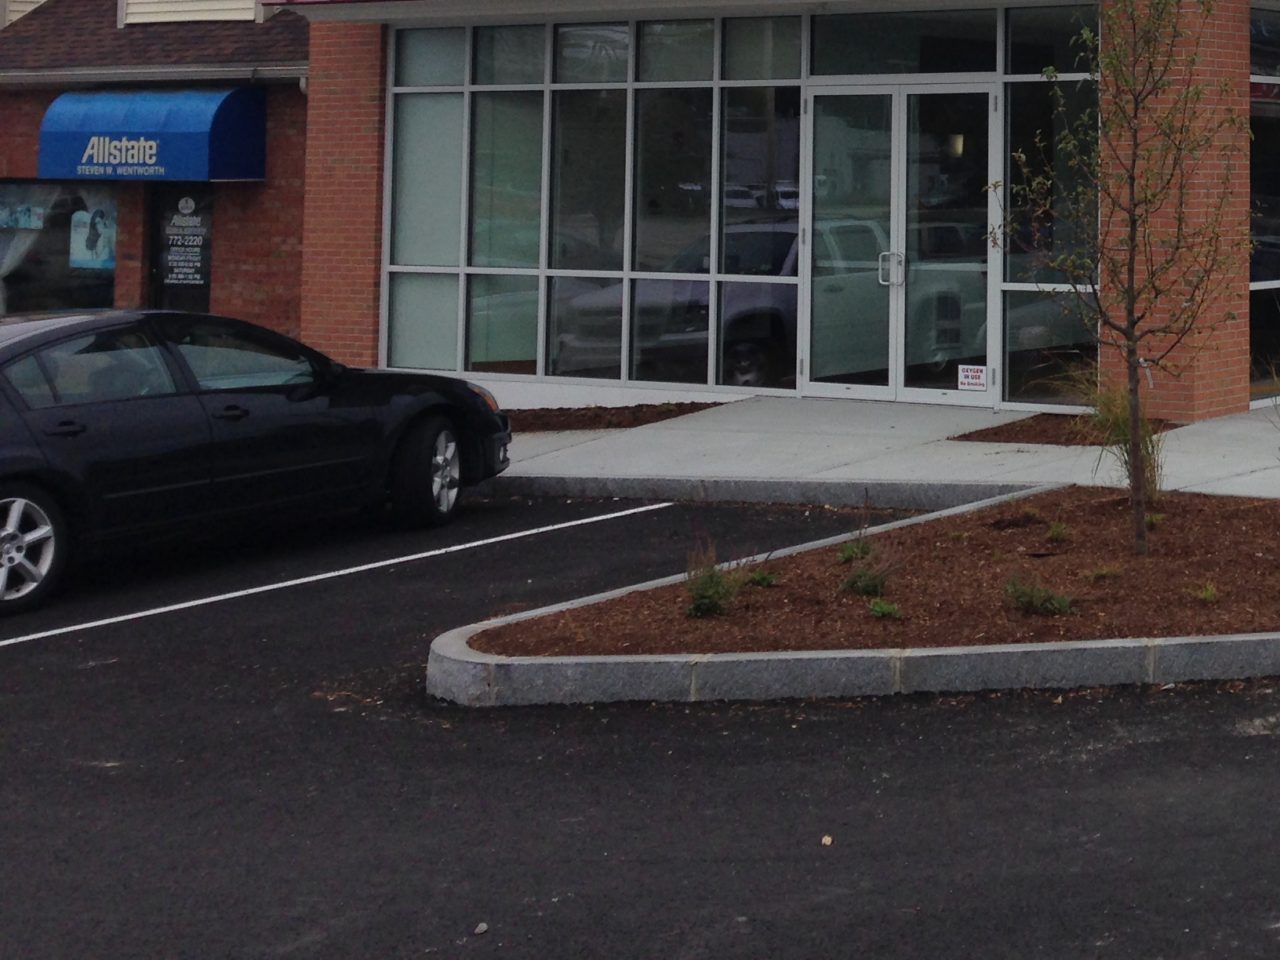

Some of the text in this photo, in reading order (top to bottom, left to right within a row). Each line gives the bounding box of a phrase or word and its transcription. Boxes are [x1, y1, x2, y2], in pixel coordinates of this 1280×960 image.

[81, 136, 157, 165] Allstate
[77, 166, 104, 175] STEVEN
[116, 166, 165, 176] WENTWORTH
[168, 235, 203, 245] 772-2220
